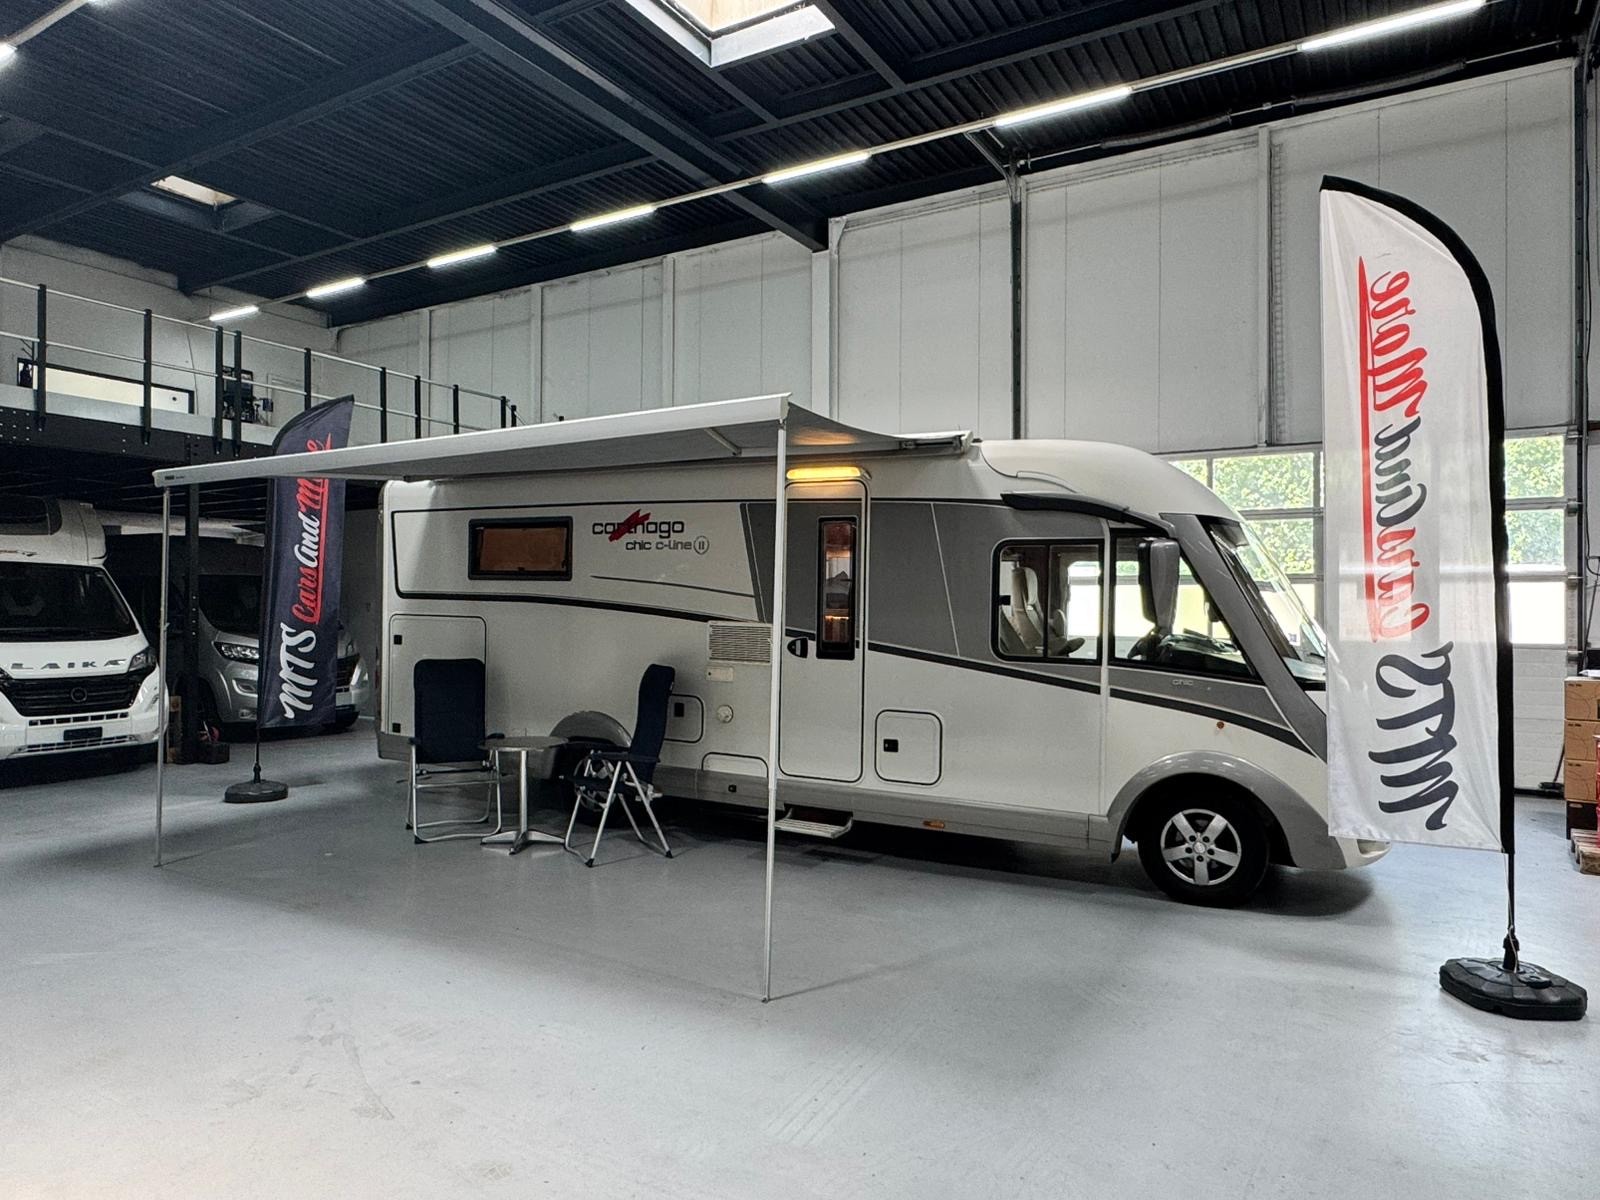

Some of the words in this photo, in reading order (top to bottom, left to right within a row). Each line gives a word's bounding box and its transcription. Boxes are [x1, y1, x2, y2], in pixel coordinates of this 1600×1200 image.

[625, 540, 652, 551] chic
[655, 540, 692, 550] c-line
[11, 658, 126, 670] LAIKA
[280, 622, 317, 719] MTS
